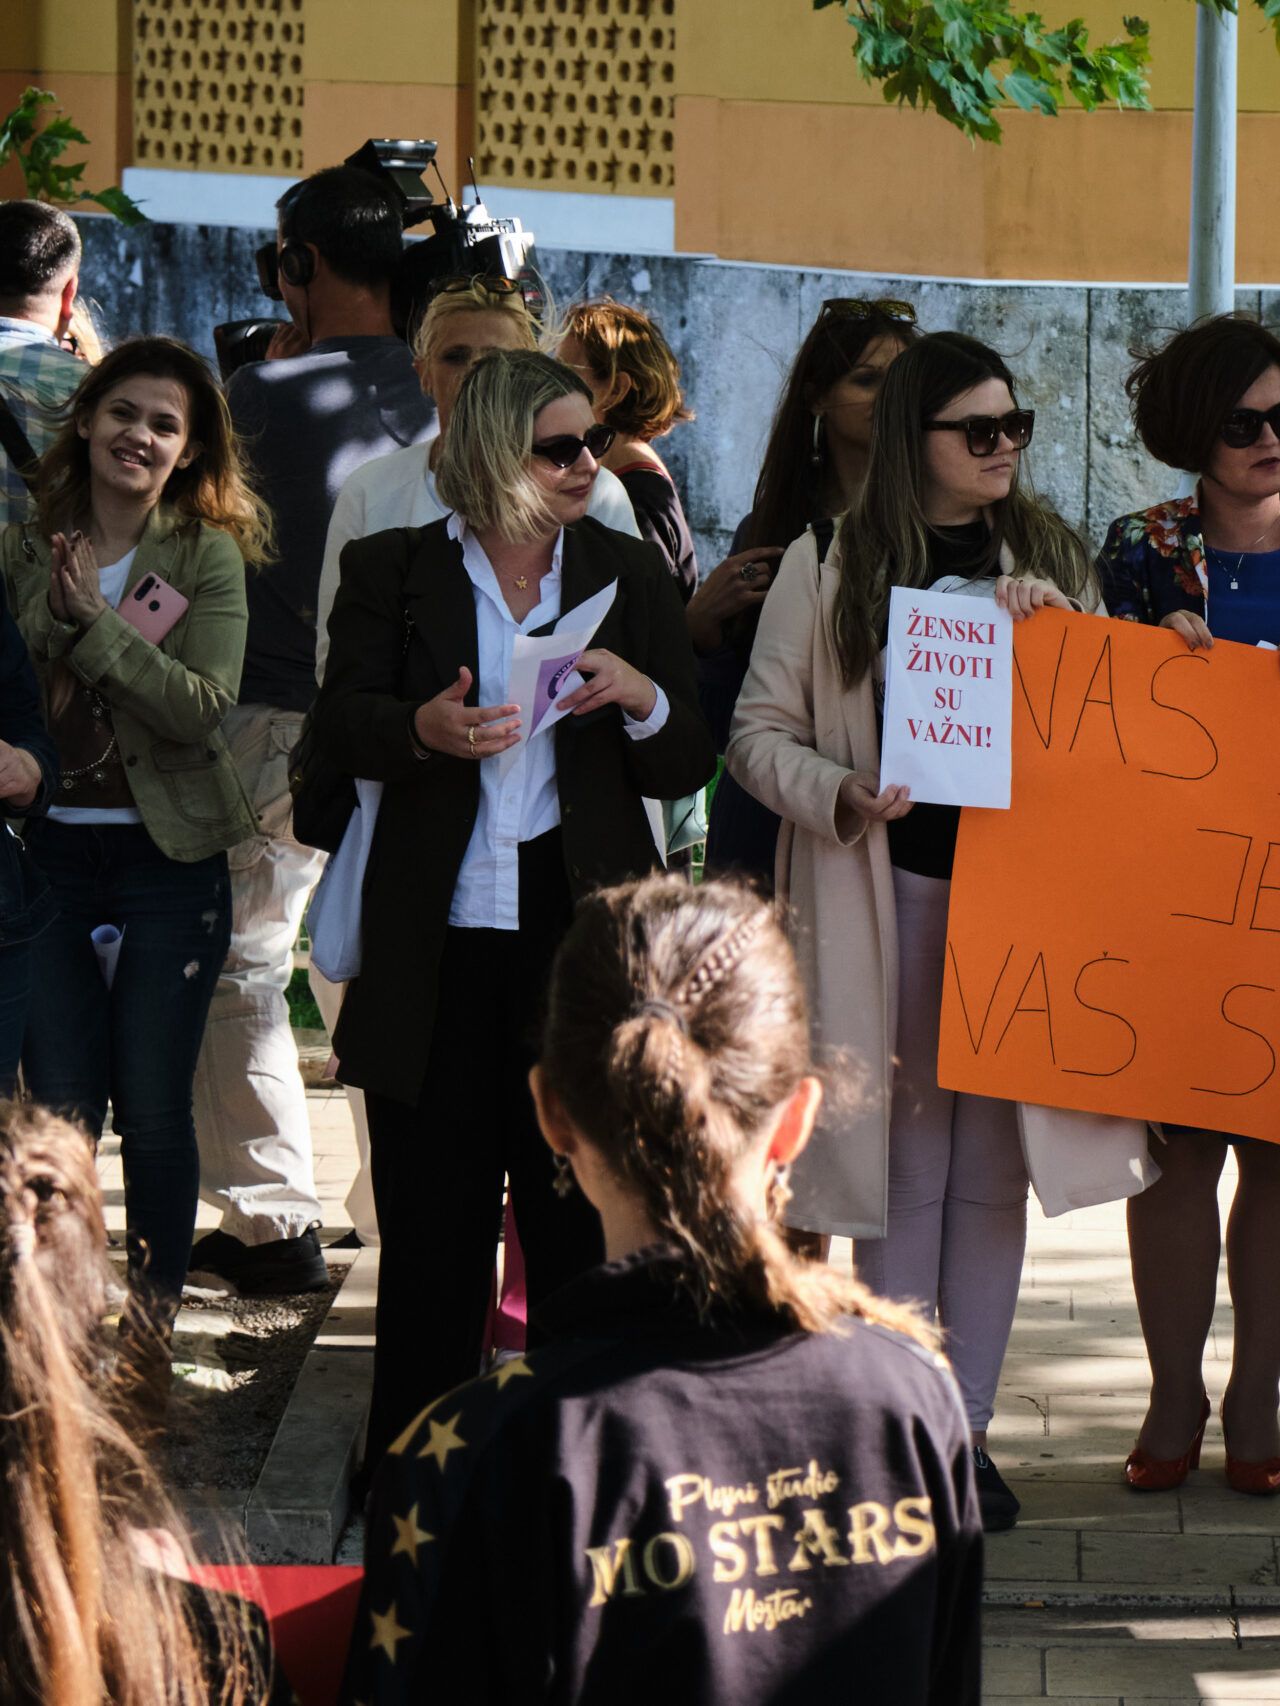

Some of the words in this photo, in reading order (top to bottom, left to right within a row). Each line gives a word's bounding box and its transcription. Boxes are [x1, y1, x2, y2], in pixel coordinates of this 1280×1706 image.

[906, 607, 996, 645] ŽENSKI
[906, 642, 994, 679] ŽIVOTI
[934, 686, 963, 711] SU
[906, 715, 993, 748] VAŽNI!
[948, 941, 1138, 1077] VAŠ
[766, 1458, 840, 1509] studio
[722, 1587, 813, 1635] Mostar
